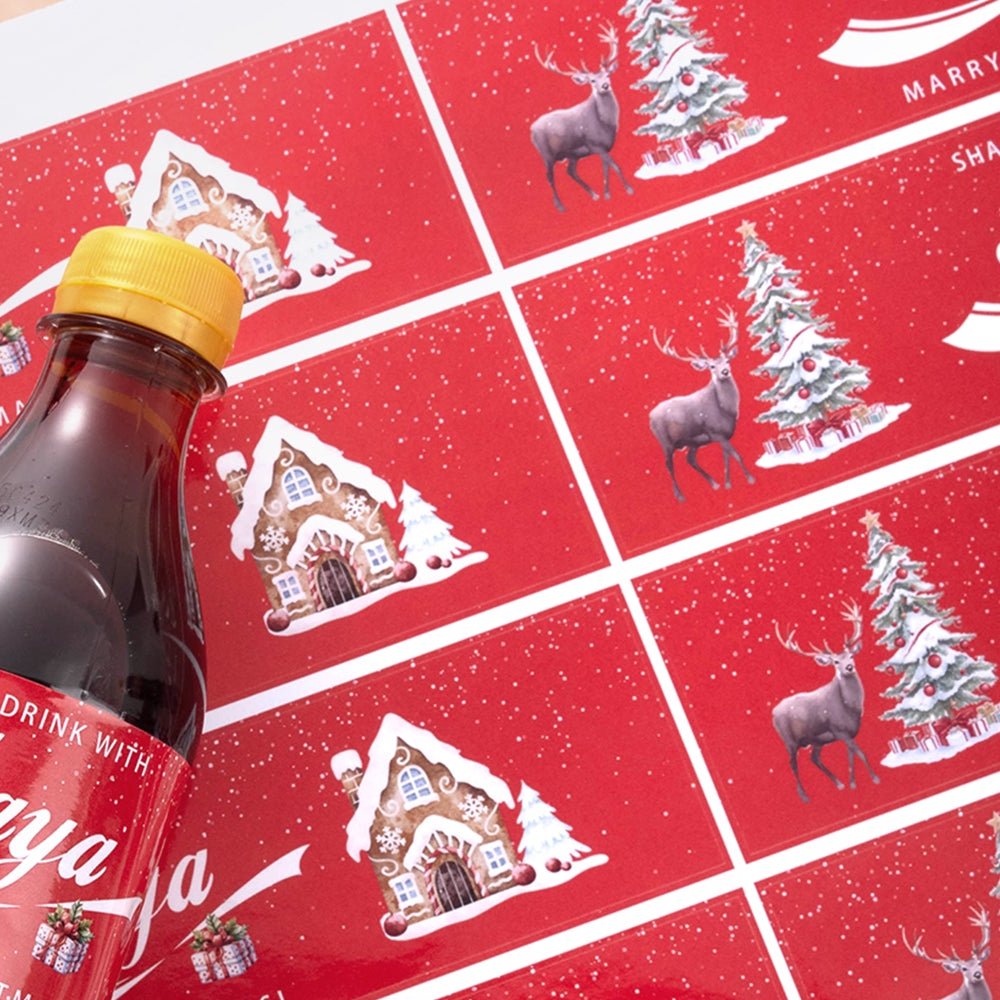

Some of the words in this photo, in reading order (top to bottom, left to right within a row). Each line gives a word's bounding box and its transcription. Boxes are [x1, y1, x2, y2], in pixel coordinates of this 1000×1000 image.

[902, 51, 999, 104] MARRY
[0, 693, 88, 746] DRINK
[95, 730, 152, 778] WITH
